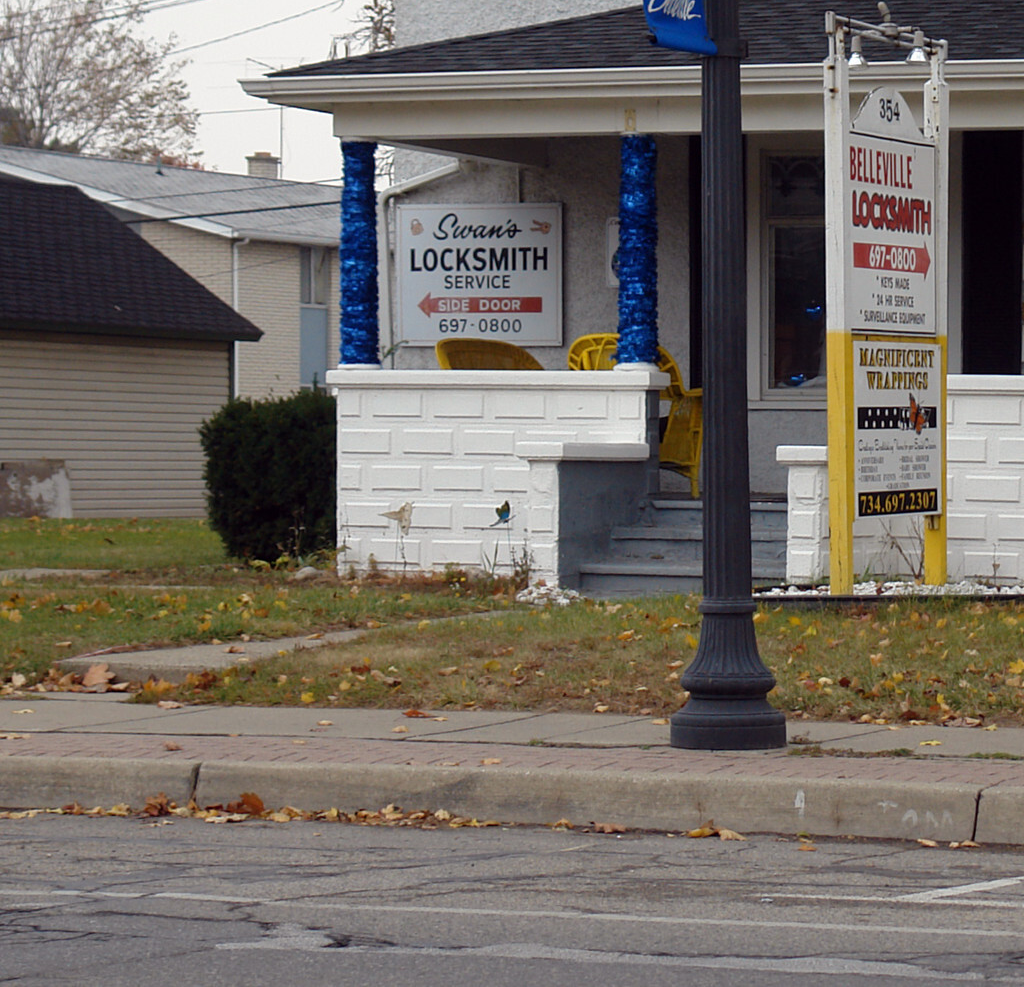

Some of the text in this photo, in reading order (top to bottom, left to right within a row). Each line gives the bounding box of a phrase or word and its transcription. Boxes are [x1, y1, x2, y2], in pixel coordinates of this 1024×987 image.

[879, 98, 901, 122] 354
[850, 146, 913, 190] BELLEVILLE
[852, 190, 932, 236] LOCKSMITH
[433, 213, 522, 241] Swan's
[410, 247, 549, 272] LOCKSMITH
[868, 244, 917, 271] 697-0800
[444, 275, 512, 290] SERVICE
[880, 276, 910, 290] KEYS MADE
[437, 299, 521, 312] SIDE DOOR
[876, 294, 914, 308] 24 HR SERVICE
[438, 318, 522, 333] 697-0800
[864, 310, 926, 325] SURVEILLANCE EQUIPMENT
[859, 347, 935, 369] MAGNIFICENT
[866, 371, 929, 391] WRAPPINGS
[859, 490, 937, 514] 734.697.2307
